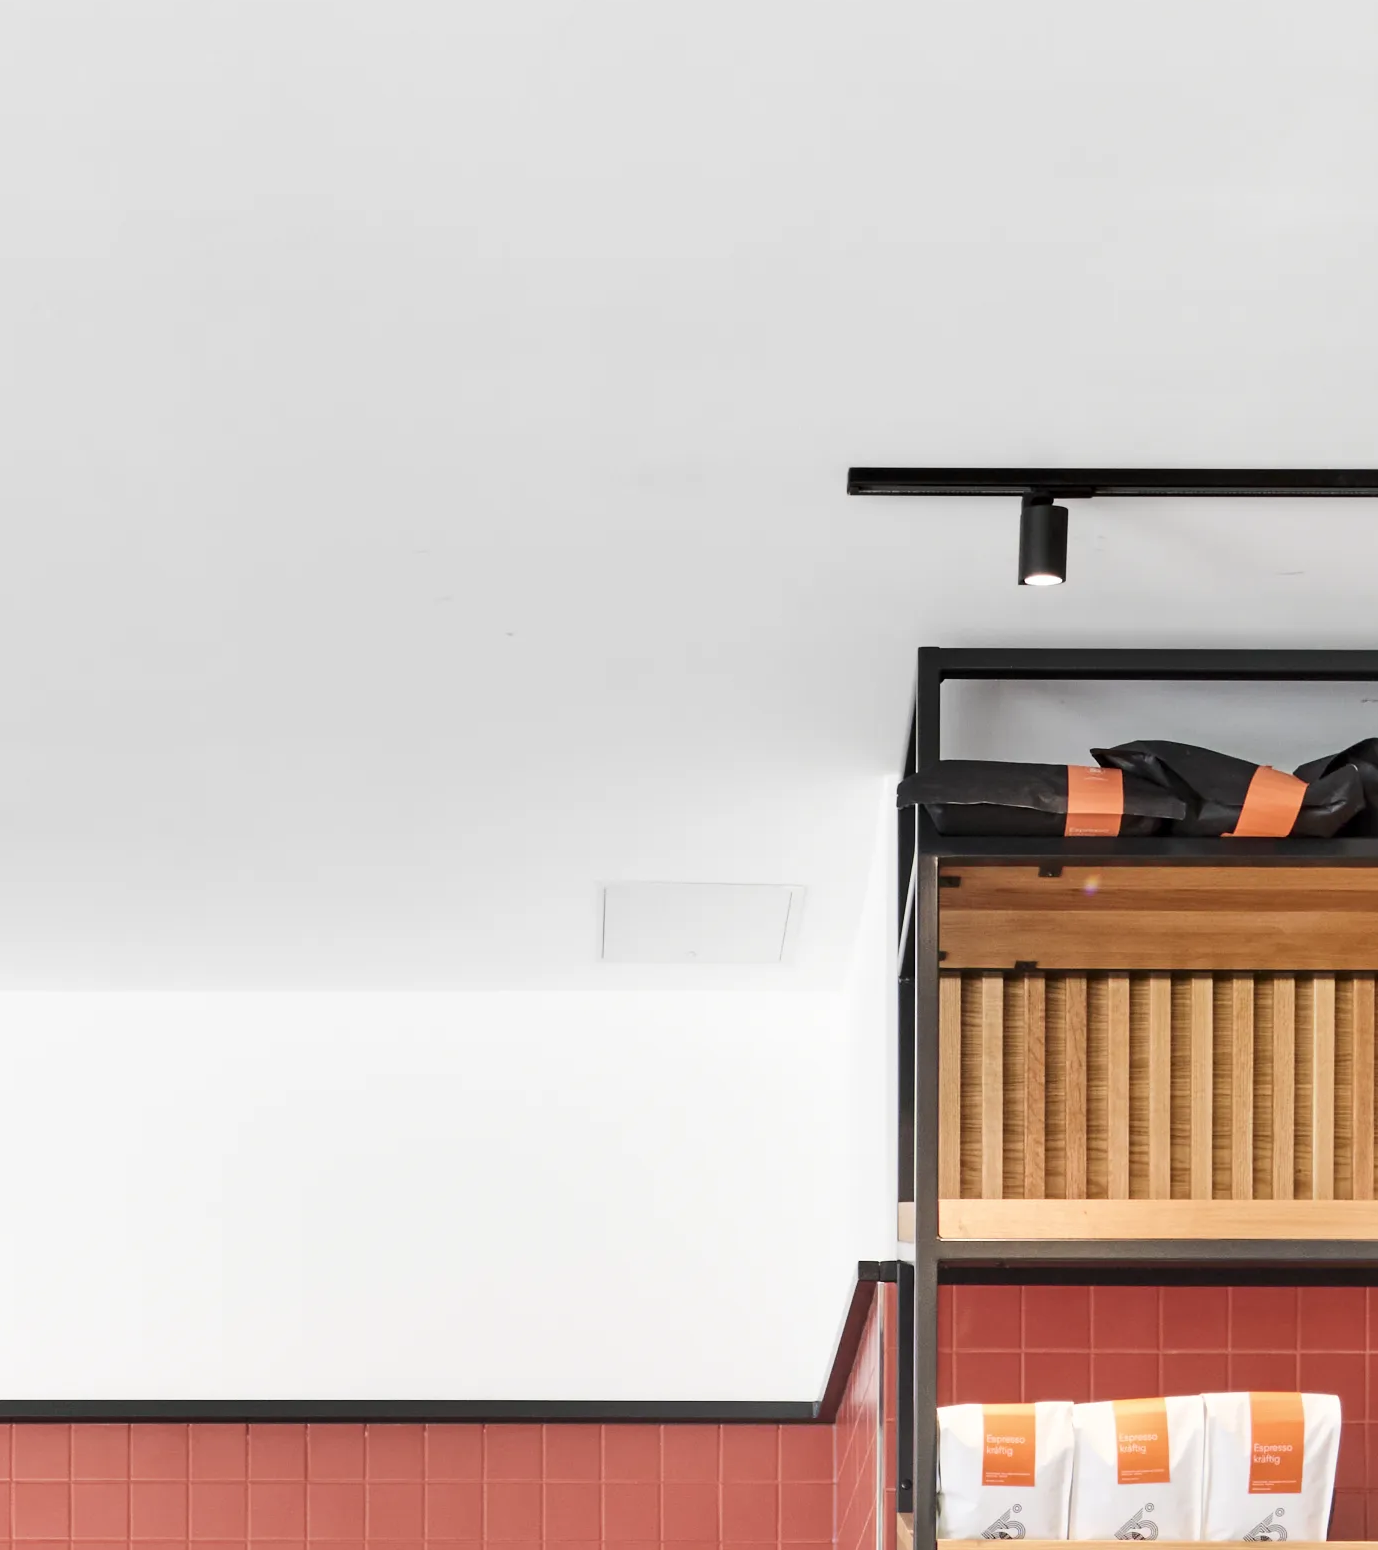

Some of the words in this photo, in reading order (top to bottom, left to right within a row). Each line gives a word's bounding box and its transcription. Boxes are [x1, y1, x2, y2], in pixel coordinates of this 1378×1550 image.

[987, 1435, 1025, 1444] Espresso
[1119, 1433, 1158, 1443] Espresso
[1254, 1443, 1293, 1452] Espresso
[1254, 1455, 1280, 1465] kräftig
